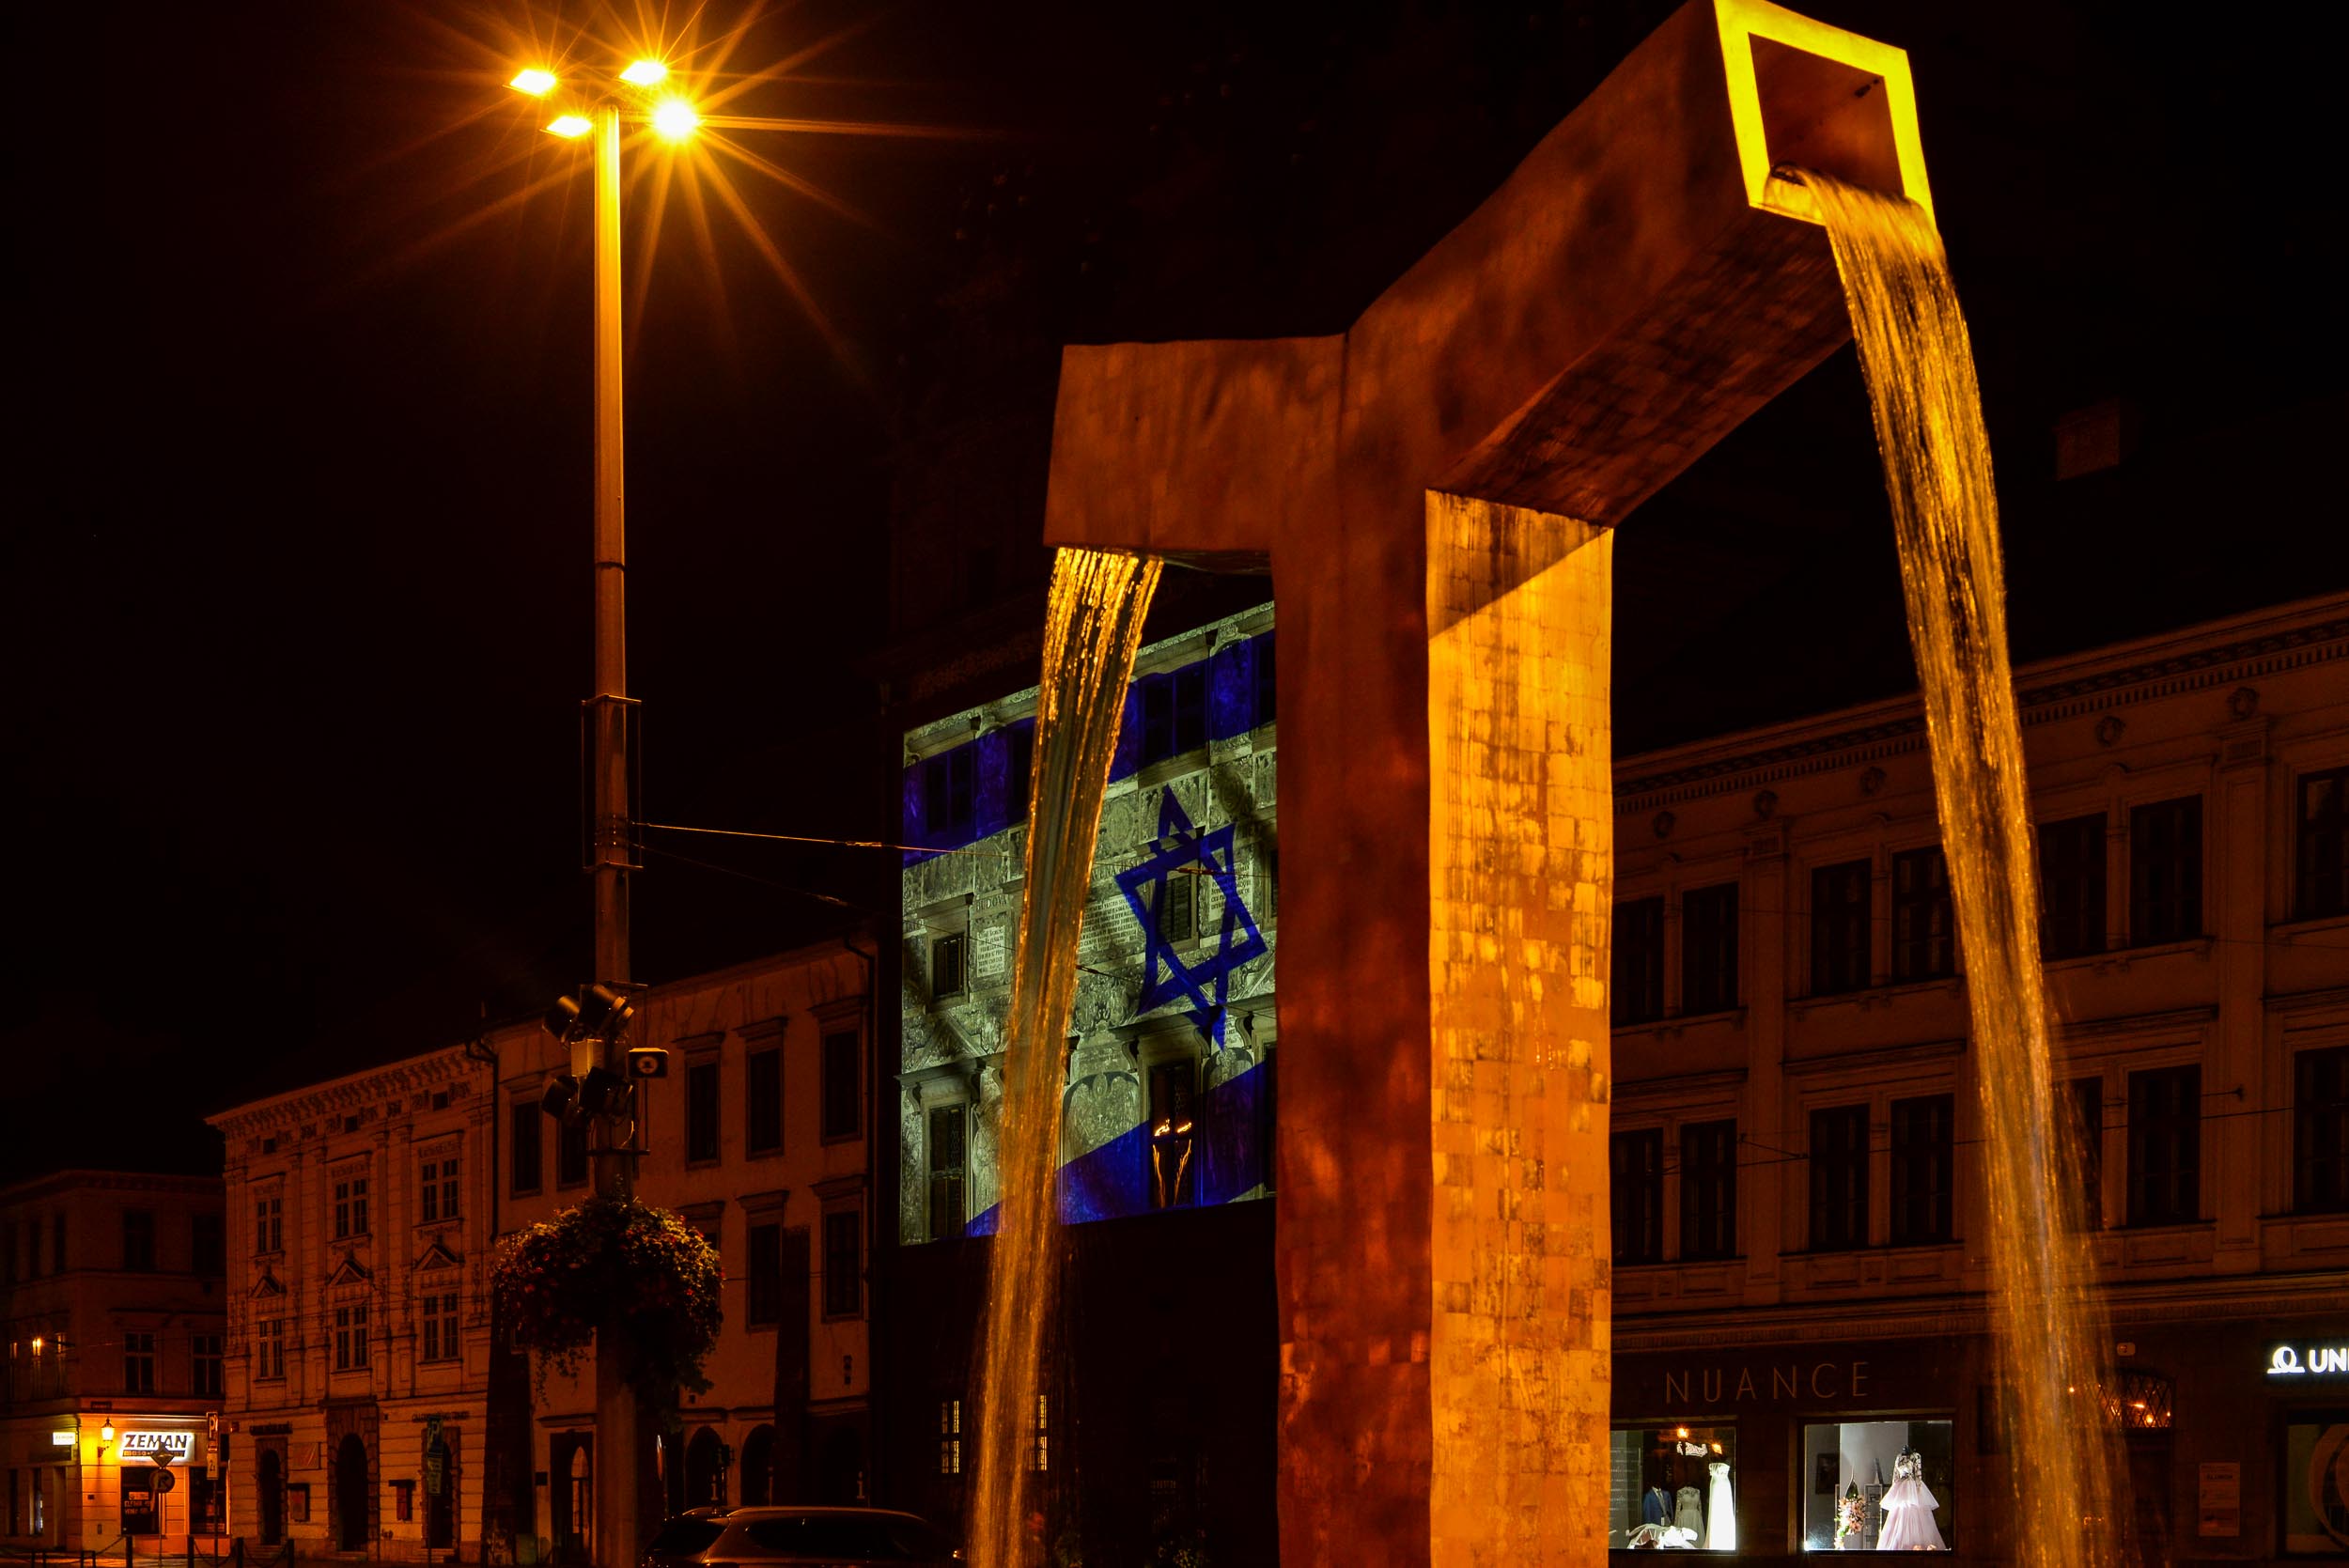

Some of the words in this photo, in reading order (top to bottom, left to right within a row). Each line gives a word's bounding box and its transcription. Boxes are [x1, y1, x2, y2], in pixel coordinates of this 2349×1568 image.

[2309, 1348, 2349, 1373] UN
[1664, 1360, 1871, 1405] NUANCE
[124, 1434, 187, 1449] ZEMAN
